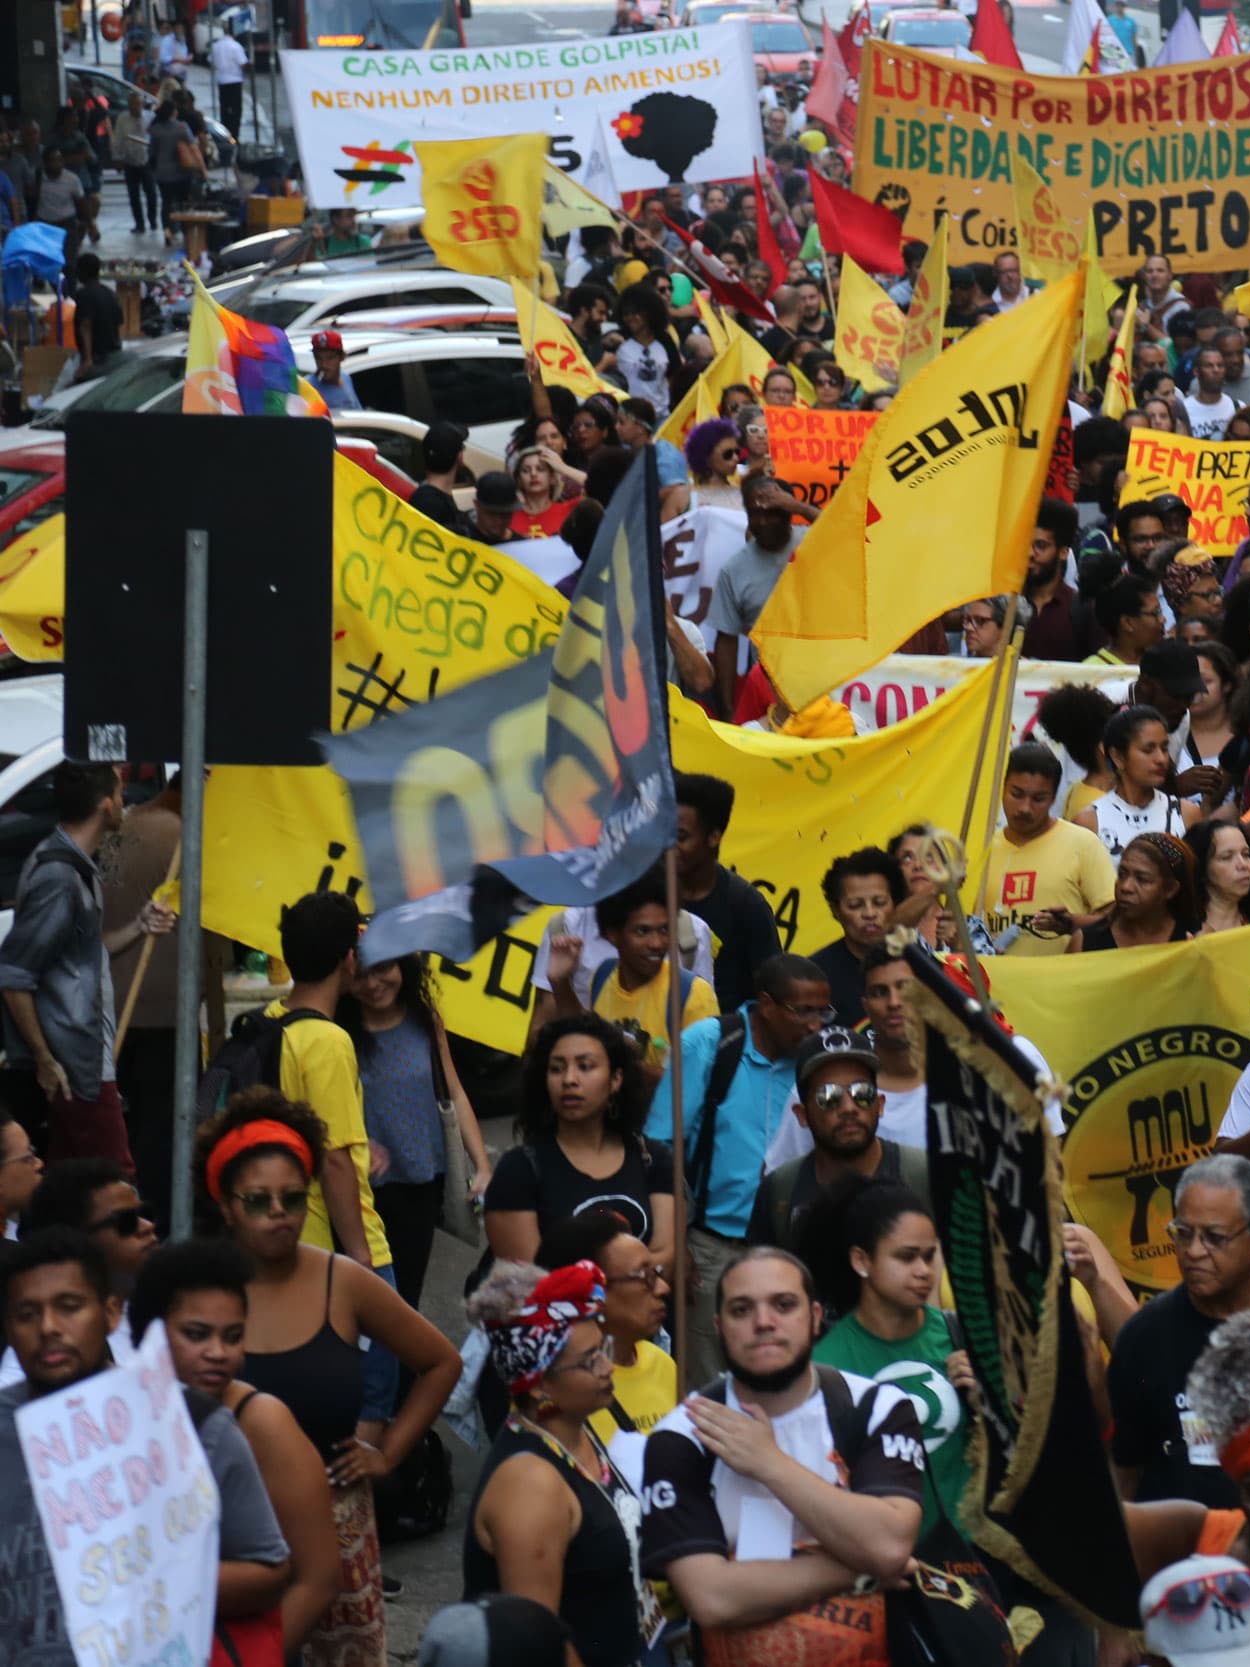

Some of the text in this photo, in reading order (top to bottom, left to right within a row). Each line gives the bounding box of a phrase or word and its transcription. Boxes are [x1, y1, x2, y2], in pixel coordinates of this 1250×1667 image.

[342, 31, 701, 77] CASA GRANDE GOLPISTA!
[311, 88, 453, 109] NENHUM
[462, 79, 575, 105] DIREITO
[871, 50, 1000, 119] LUTAR
[1064, 143, 1084, 177] E
[766, 410, 826, 434] POR
[1131, 439, 1196, 480] TEM
[1178, 481, 1224, 513] NA
[352, 486, 504, 596] Chega
[338, 551, 488, 658] Chega
[1107, 1030, 1241, 1078] NEGRO
[29, 1395, 132, 1480] NÃO
